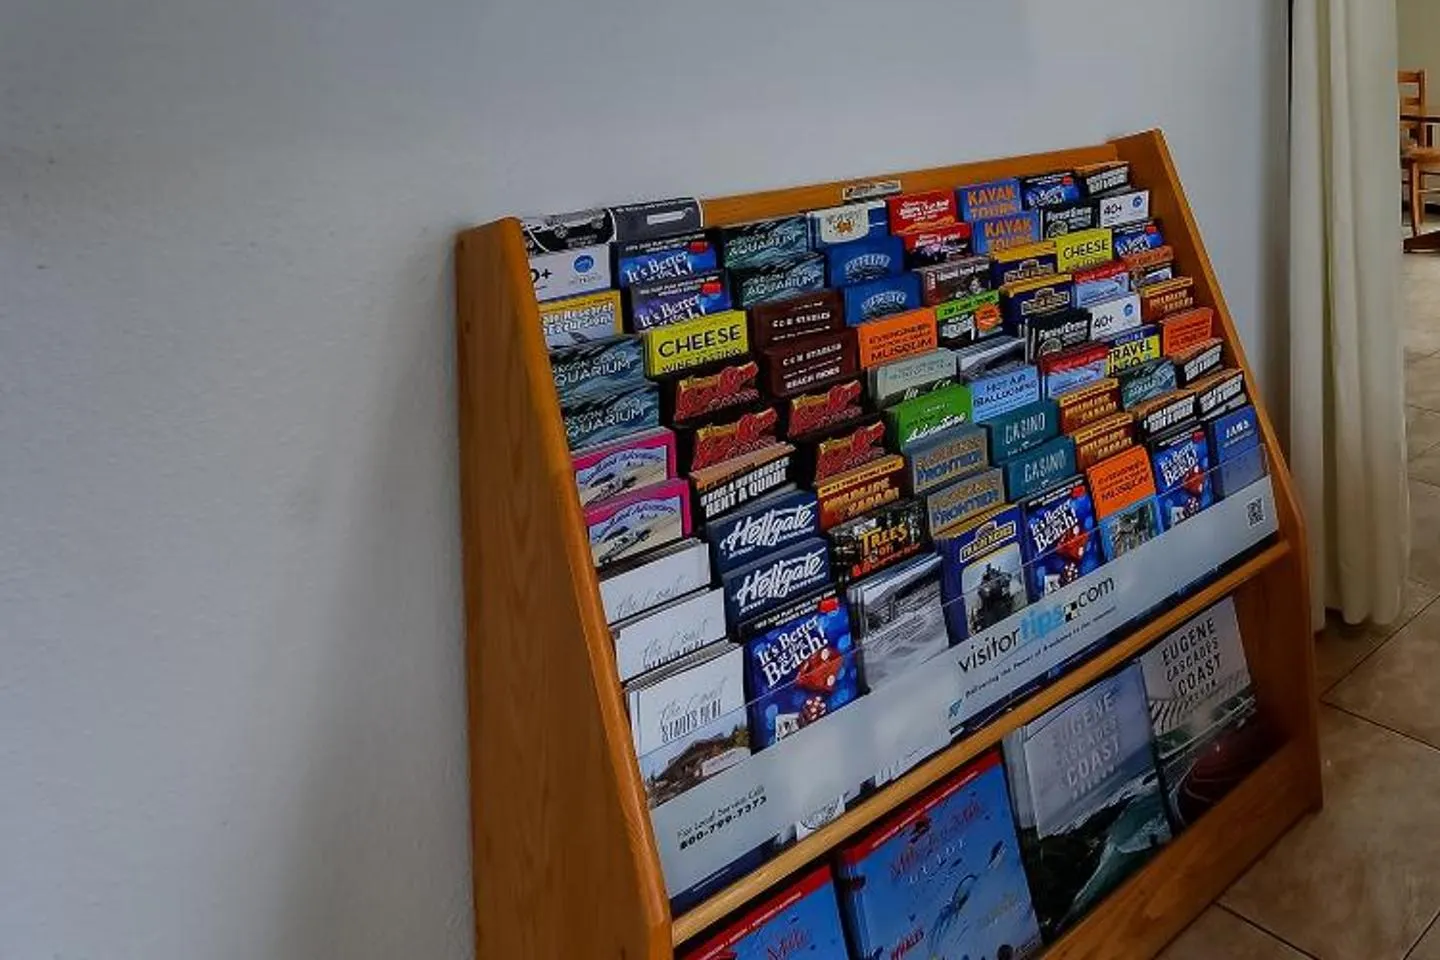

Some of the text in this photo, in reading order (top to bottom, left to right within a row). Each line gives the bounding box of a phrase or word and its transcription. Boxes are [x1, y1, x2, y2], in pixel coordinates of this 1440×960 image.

[1063, 239, 1109, 261] CHEESE
[627, 262, 649, 283] It's
[639, 308, 661, 327] It's
[1095, 315, 1114, 328] 40+
[658, 324, 742, 358] CHEESE
[555, 358, 631, 387] QUARIUM
[566, 408, 645, 436] QUARIUM
[1005, 412, 1046, 443] CASINO
[1024, 449, 1067, 477] CASINO
[705, 491, 737, 518] RENT
[720, 501, 818, 552] Hellgate
[1034, 507, 1078, 553] Beach!
[737, 547, 826, 607] Hellgate
[758, 616, 818, 667] It's Better
[1162, 617, 1216, 666] EUGENE
[762, 630, 829, 689] Beach!
[1166, 637, 1219, 683] CASCADES
[1178, 653, 1222, 697] COAST
